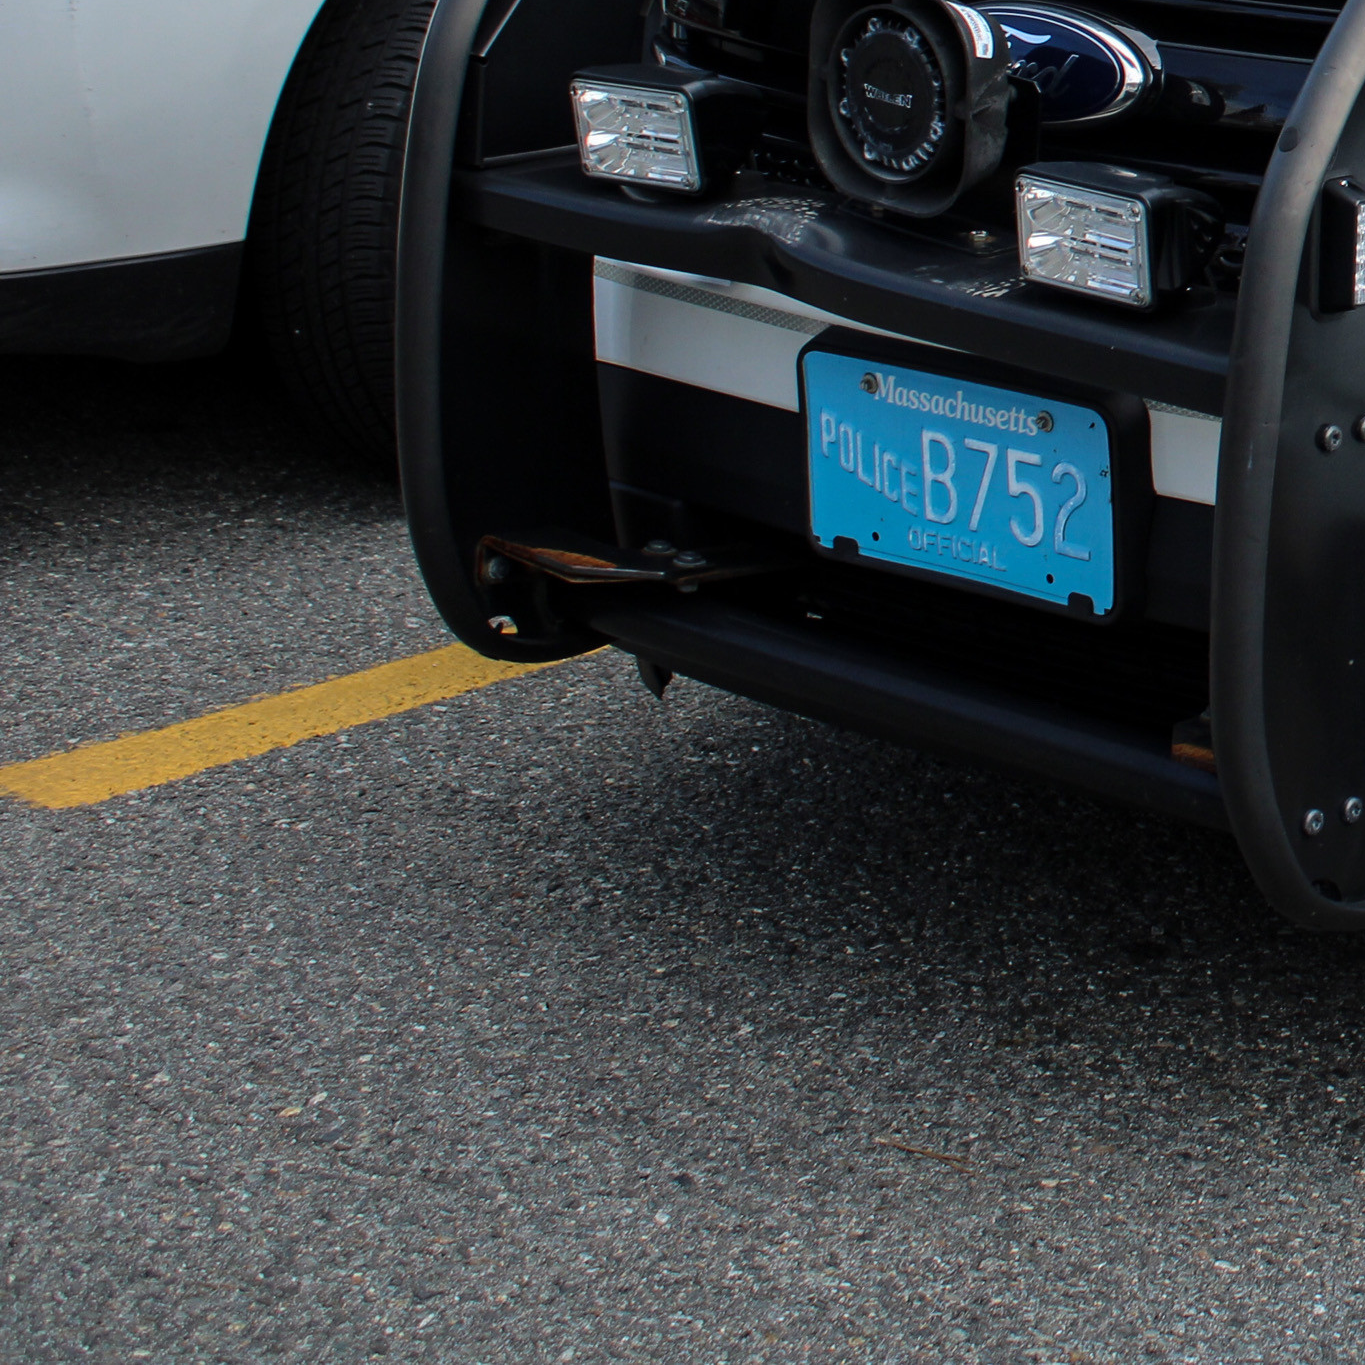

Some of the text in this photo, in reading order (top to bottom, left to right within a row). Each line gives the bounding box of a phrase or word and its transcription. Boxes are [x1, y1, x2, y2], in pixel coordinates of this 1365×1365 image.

[874, 371, 1039, 436] Massachusetts
[820, 409, 1092, 561] POLICE B752
[907, 524, 1007, 572] OFFICIAL
